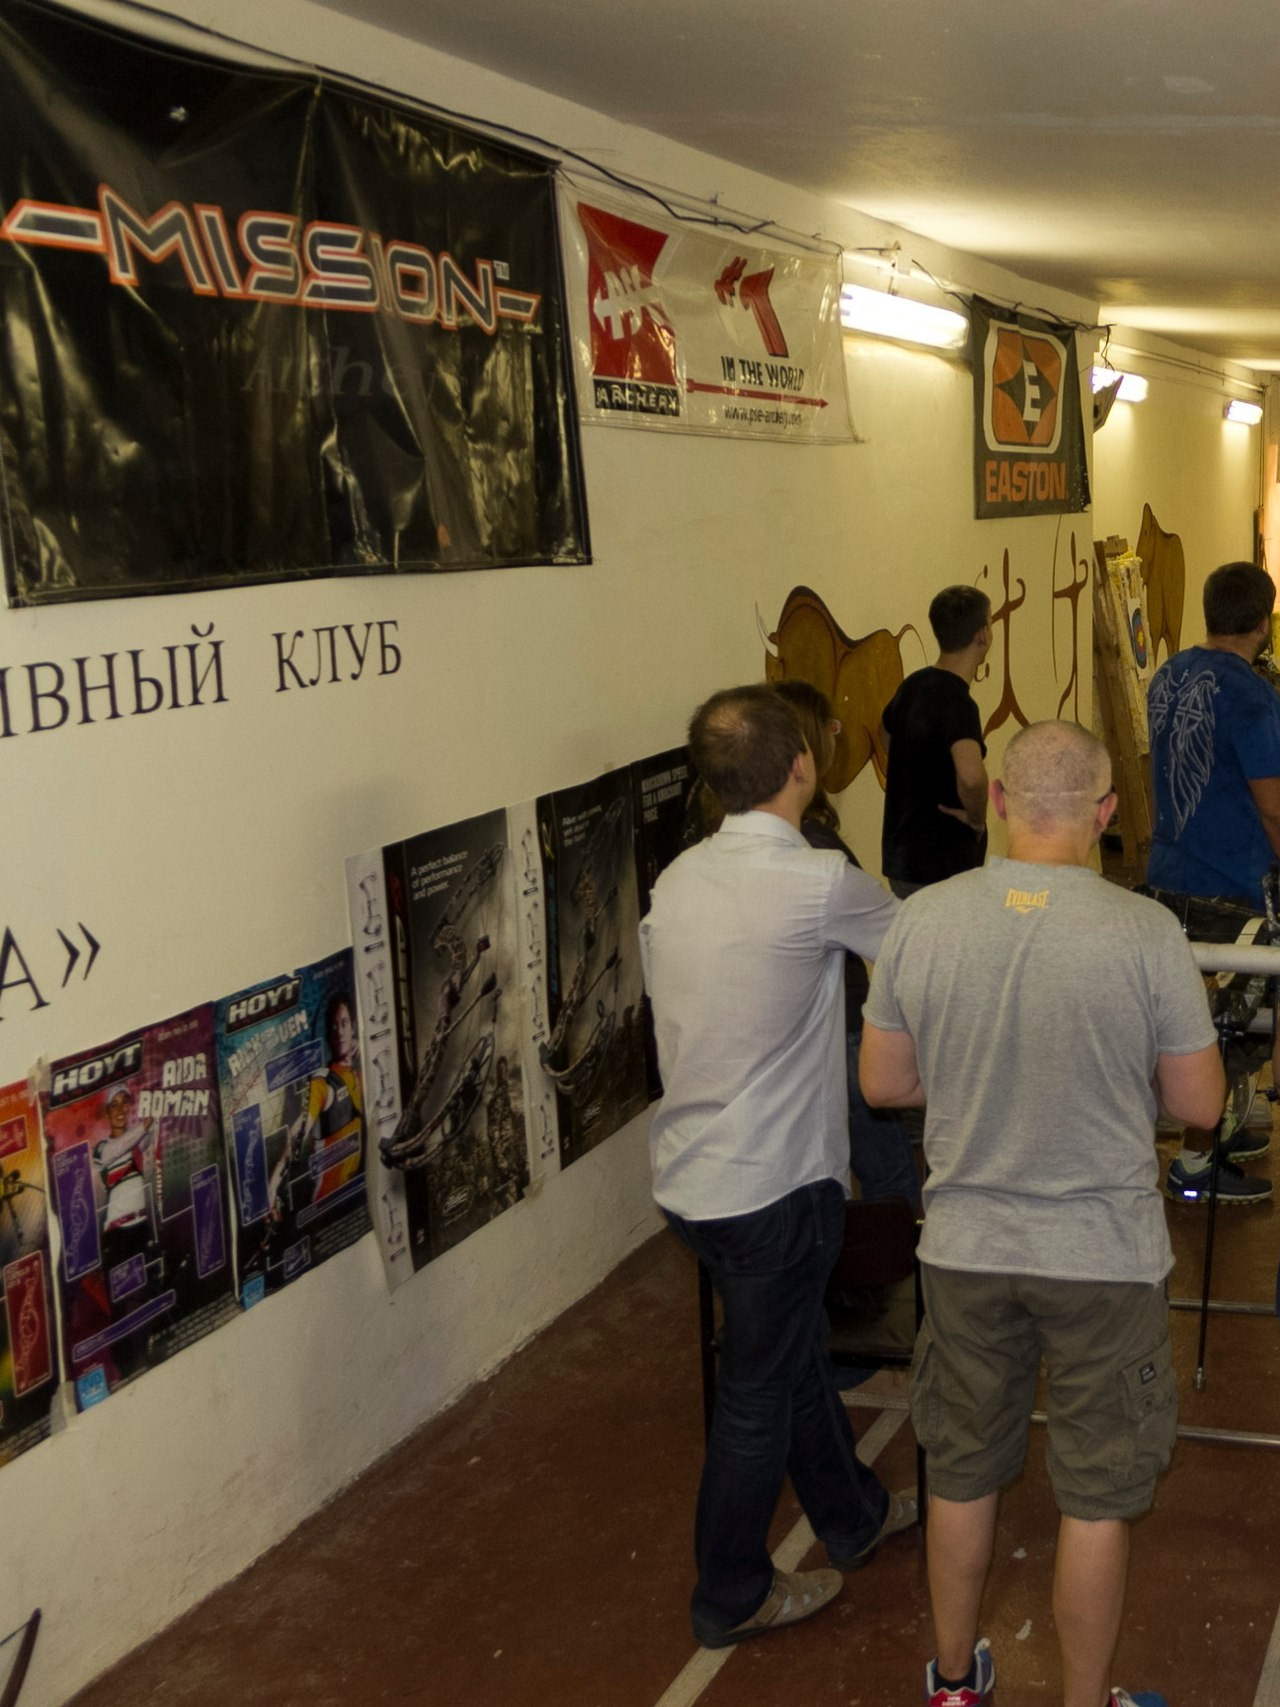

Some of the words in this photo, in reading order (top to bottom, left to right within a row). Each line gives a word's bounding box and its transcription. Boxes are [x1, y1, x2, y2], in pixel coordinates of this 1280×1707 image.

[98, 183, 496, 334] MISSION
[739, 358, 763, 386] THE
[765, 363, 804, 391] WORLD
[986, 461, 1067, 502] EASTON
[272, 619, 402, 693] КЛУБ
[411, 866, 418, 878] A
[228, 979, 300, 1024] HOYT
[53, 1042, 142, 1096] HOYT
[163, 1052, 207, 1088] AIDA
[137, 1089, 210, 1118] ROMAN
